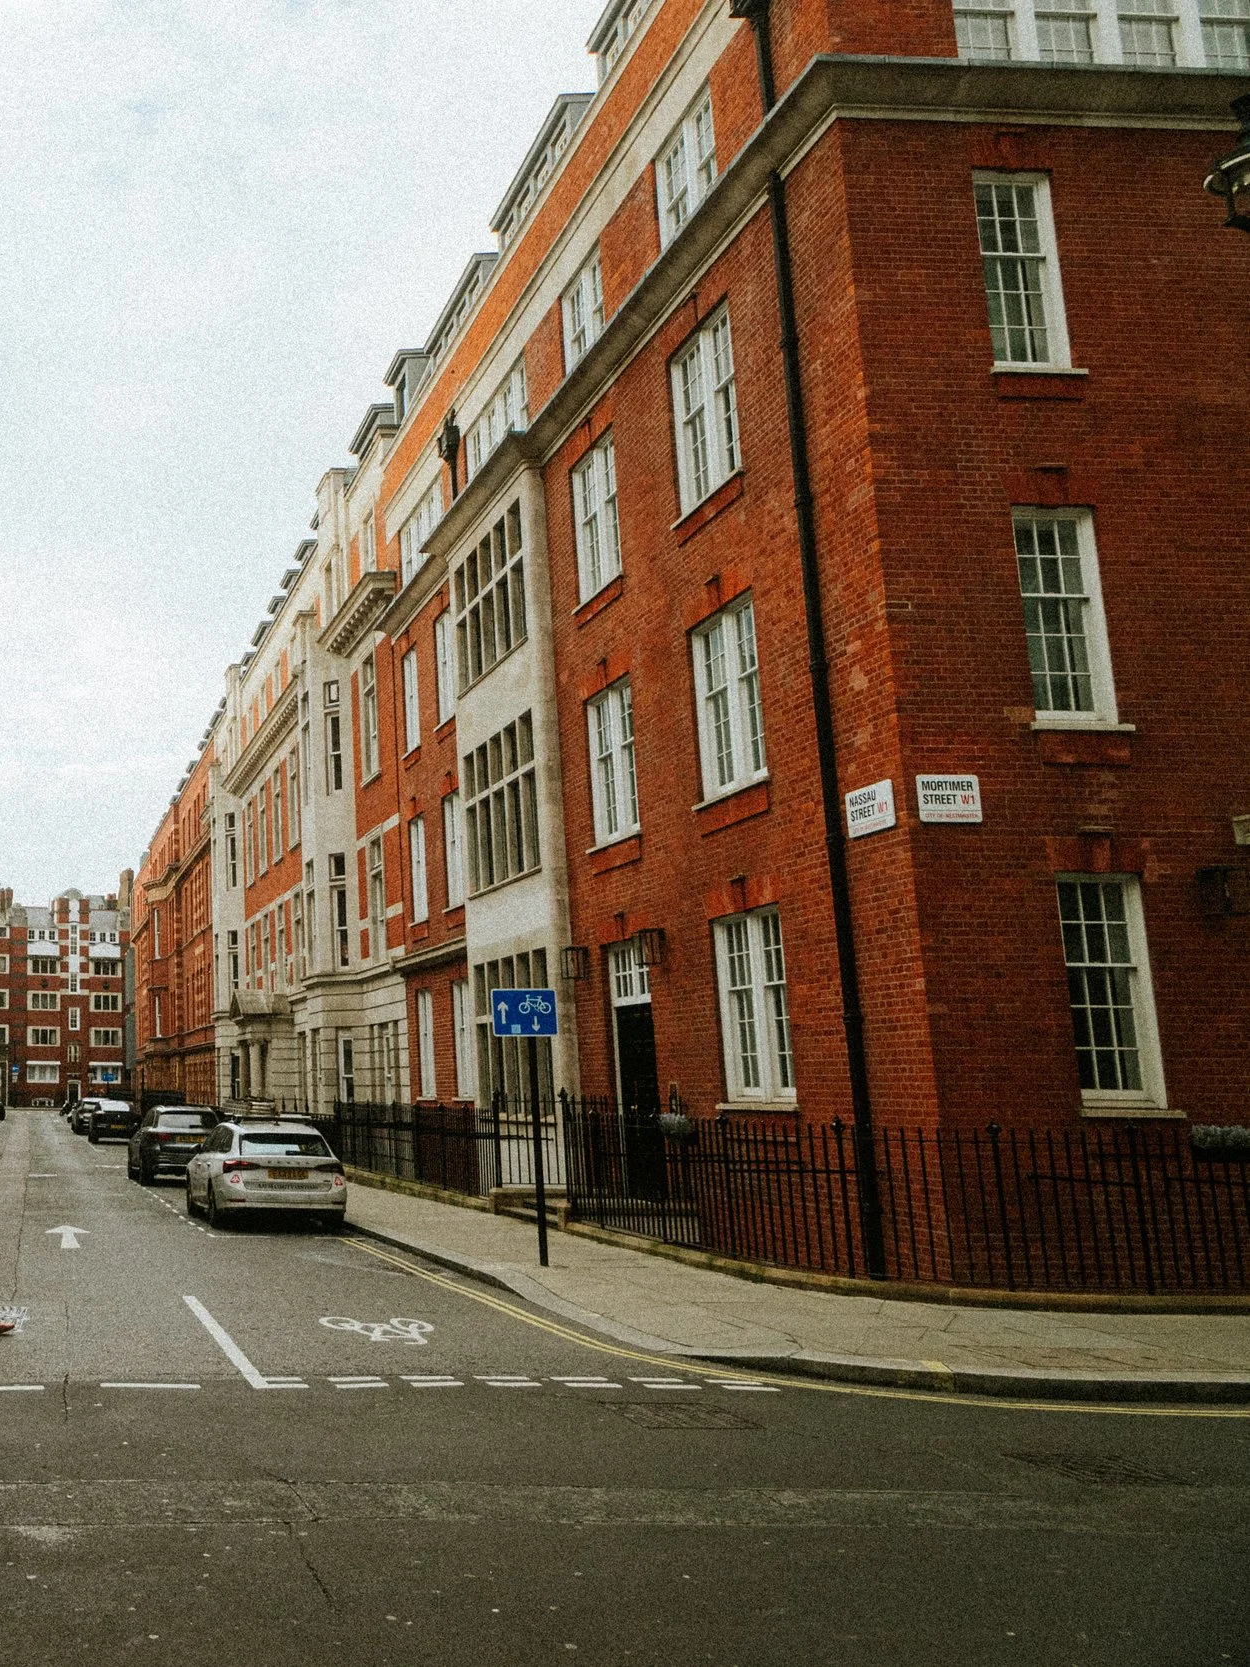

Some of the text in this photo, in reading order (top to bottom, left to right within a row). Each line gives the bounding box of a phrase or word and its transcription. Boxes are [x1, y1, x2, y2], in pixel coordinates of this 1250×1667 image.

[921, 780, 974, 791] MORTIMER
[849, 790, 876, 808] NASSAU
[923, 793, 975, 805] STREET W1
[850, 801, 888, 822] STREET W1
